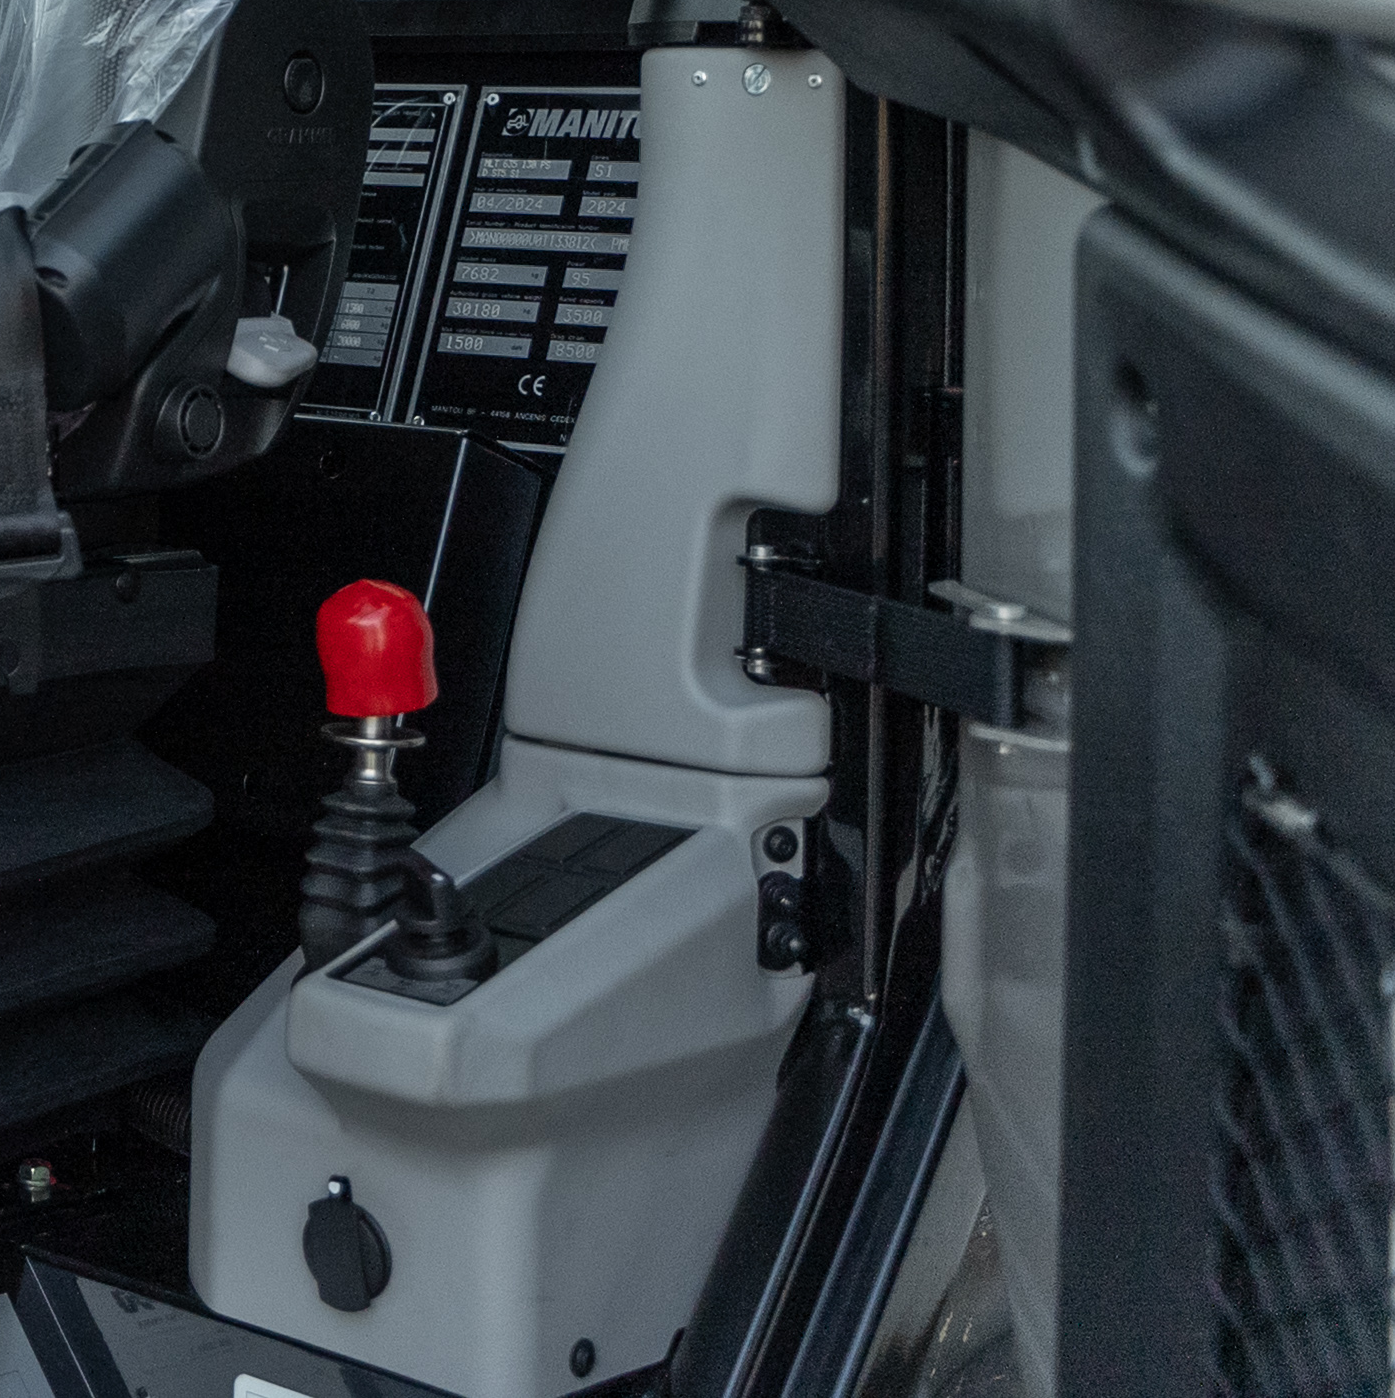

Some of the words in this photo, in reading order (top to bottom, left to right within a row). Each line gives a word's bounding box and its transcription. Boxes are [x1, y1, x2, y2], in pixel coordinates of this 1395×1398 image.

[594, 163, 613, 178] S1
[476, 195, 544, 212] 04/2024
[586, 199, 627, 215] 2024
[460, 265, 500, 282] 7682
[571, 271, 591, 286] 95
[452, 301, 501, 318] 30180
[562, 307, 604, 324] 3500
[446, 335, 484, 352] 1500
[554, 342, 596, 359] 8500
[517, 373, 547, 397] CE
[431, 404, 464, 415] MANITOU
[513, 412, 547, 422] ANCENIS
[549, 414, 576, 424] CEDEX
